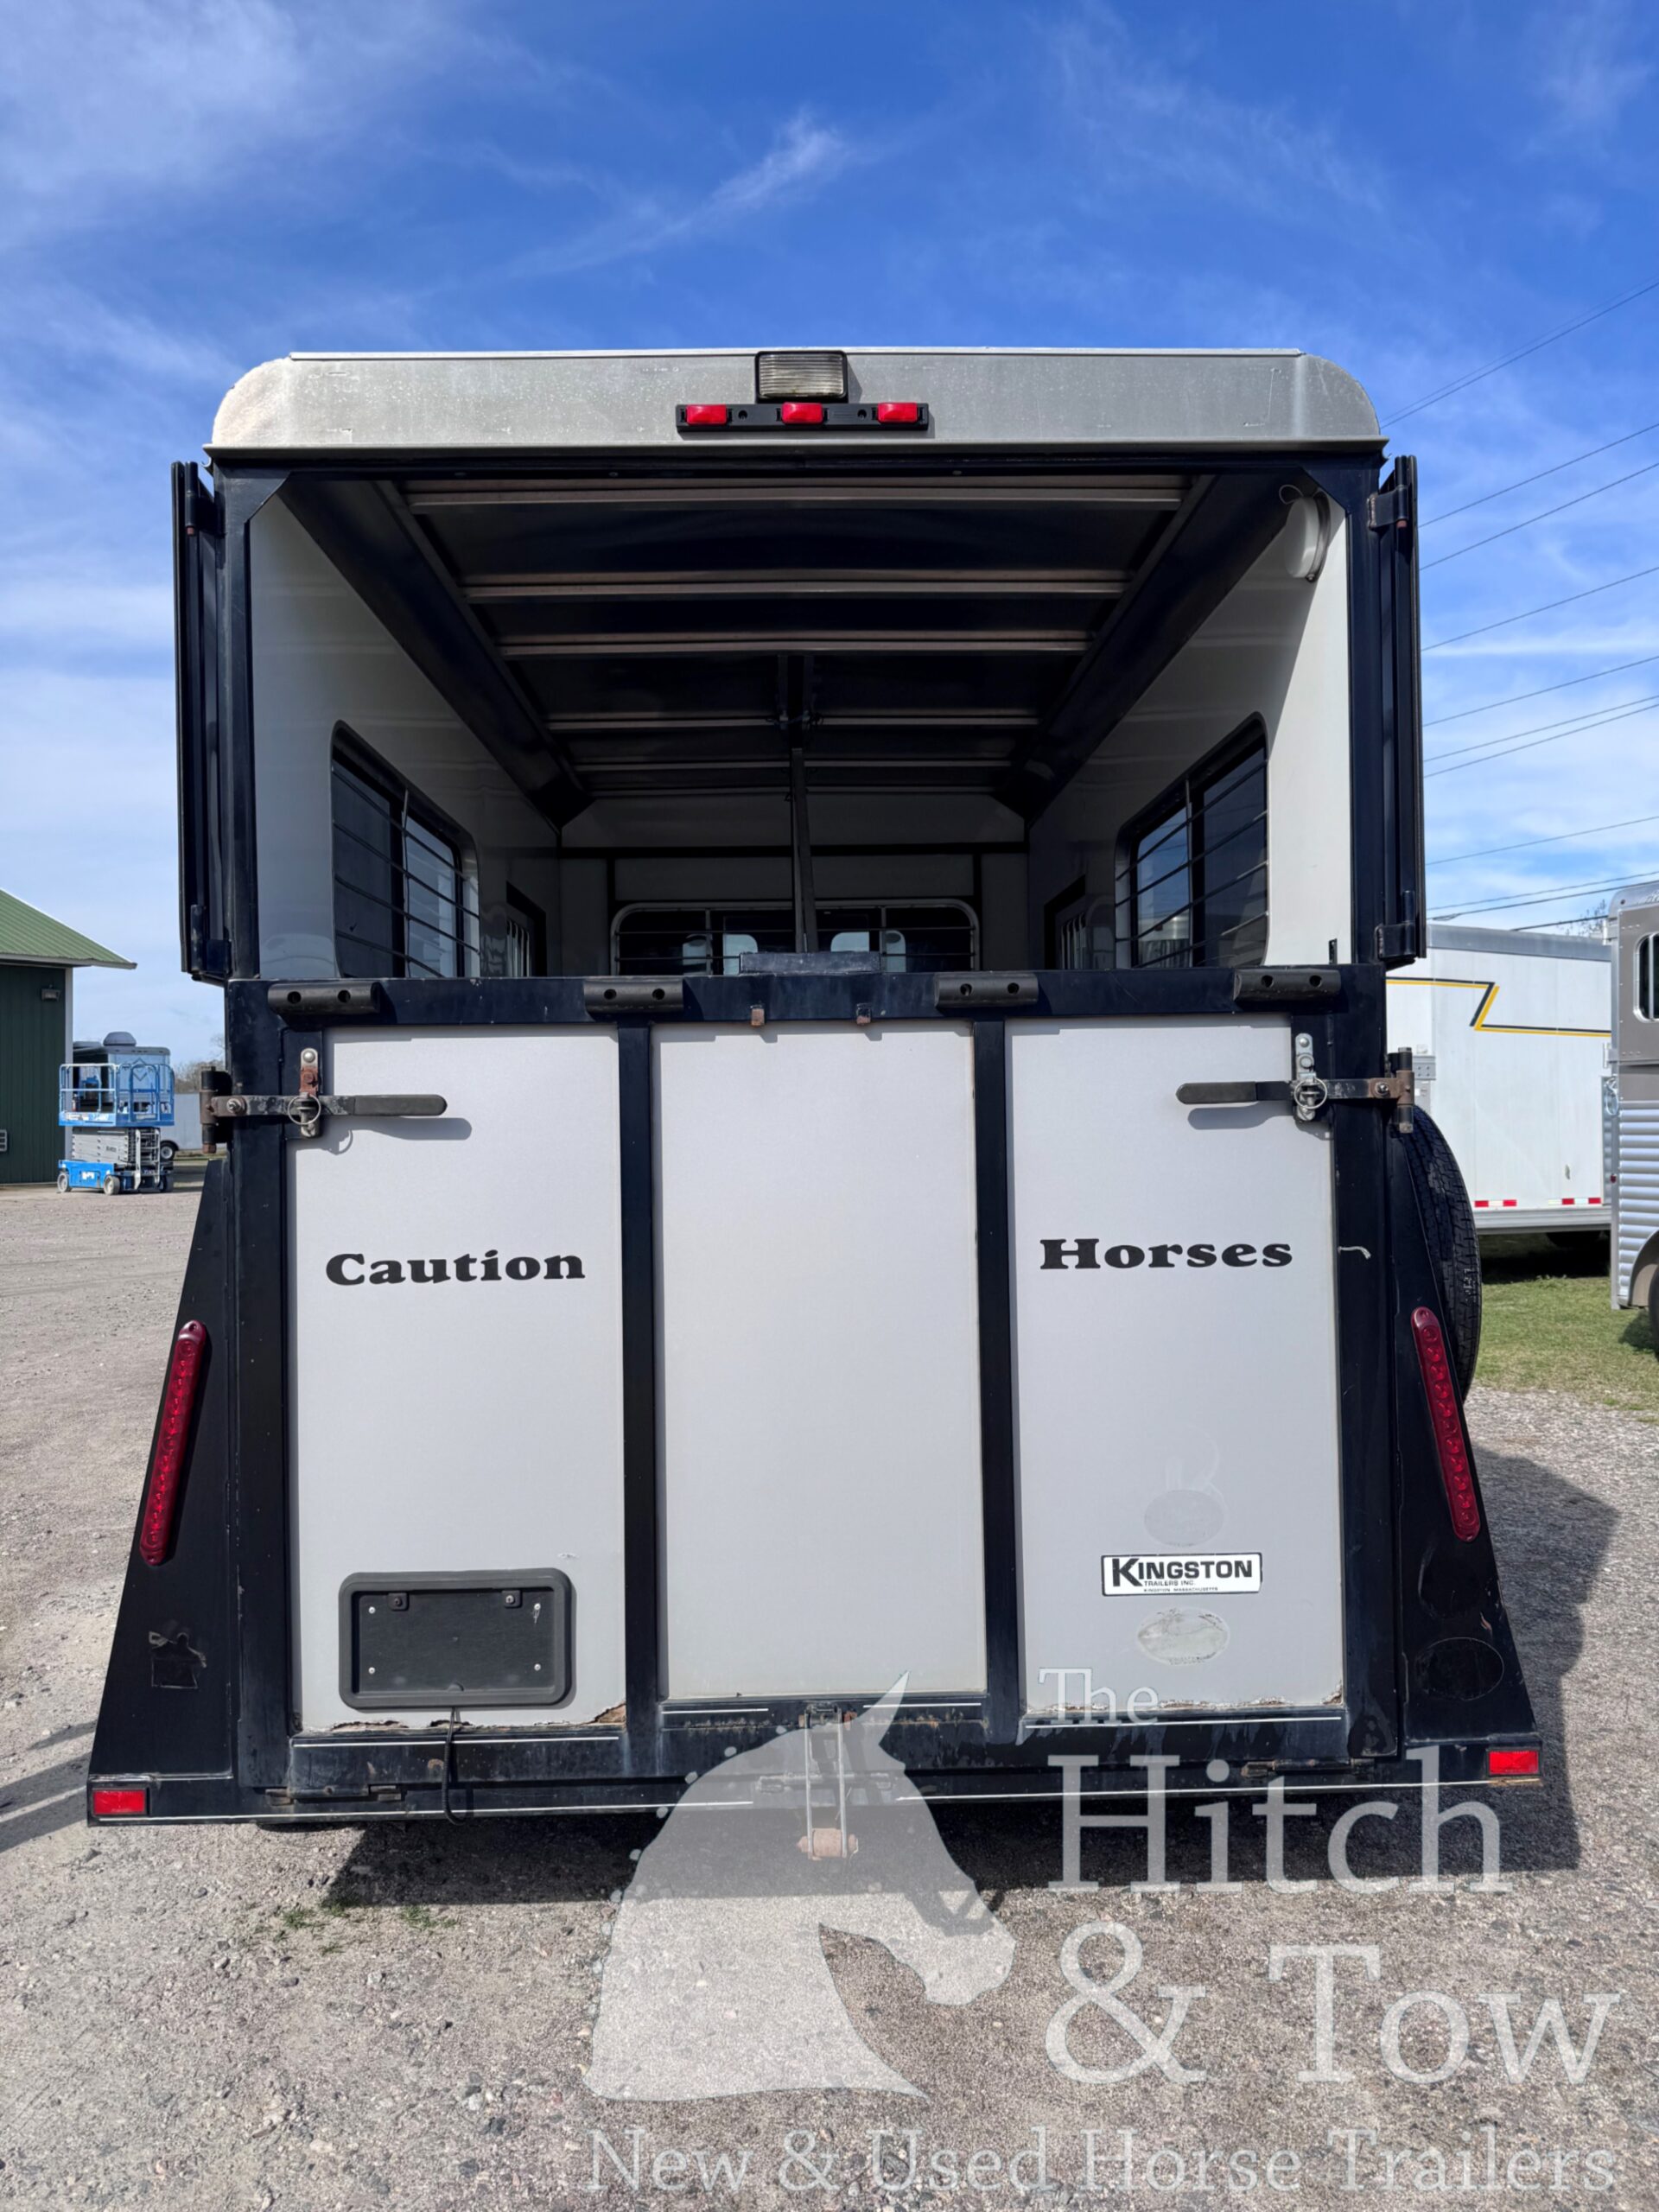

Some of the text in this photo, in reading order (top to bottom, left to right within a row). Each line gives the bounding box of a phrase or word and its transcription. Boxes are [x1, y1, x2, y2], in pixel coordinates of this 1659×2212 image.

[327, 1249, 586, 1285] Caution
[1039, 1238, 1293, 1269] Horses
[1112, 1558, 1252, 1586] KINGSTON
